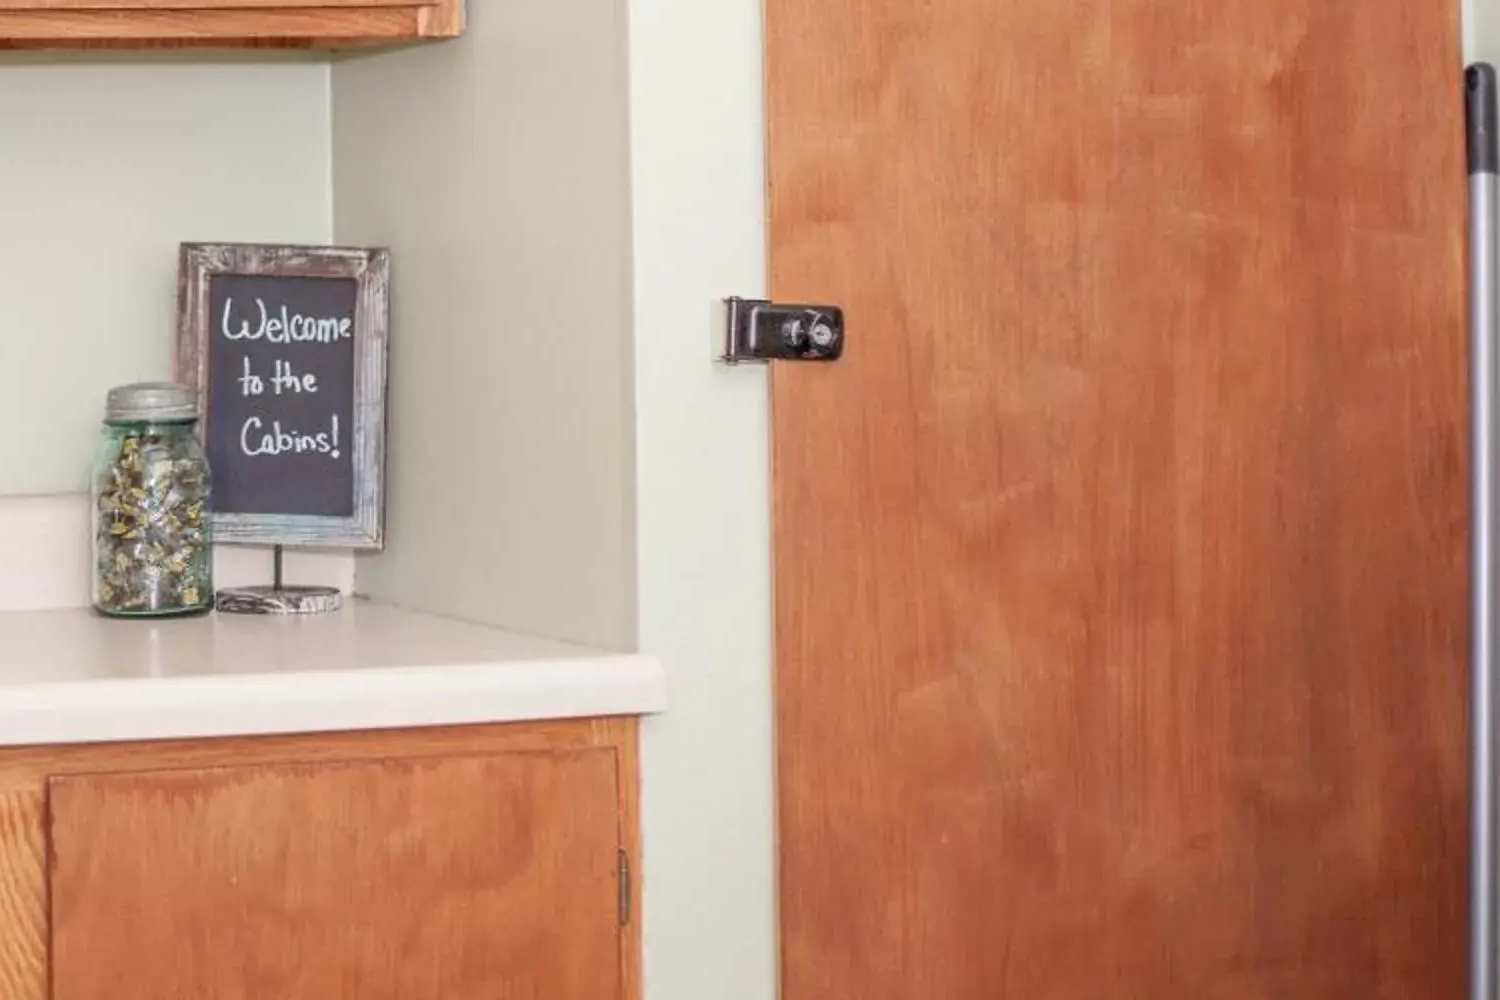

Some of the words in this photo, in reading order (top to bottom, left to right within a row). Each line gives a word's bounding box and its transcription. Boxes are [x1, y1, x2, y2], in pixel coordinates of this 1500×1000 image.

[222, 297, 352, 344] Welcome
[237, 356, 264, 396] to
[269, 359, 319, 395] the
[240, 413, 341, 460] Cabins!
